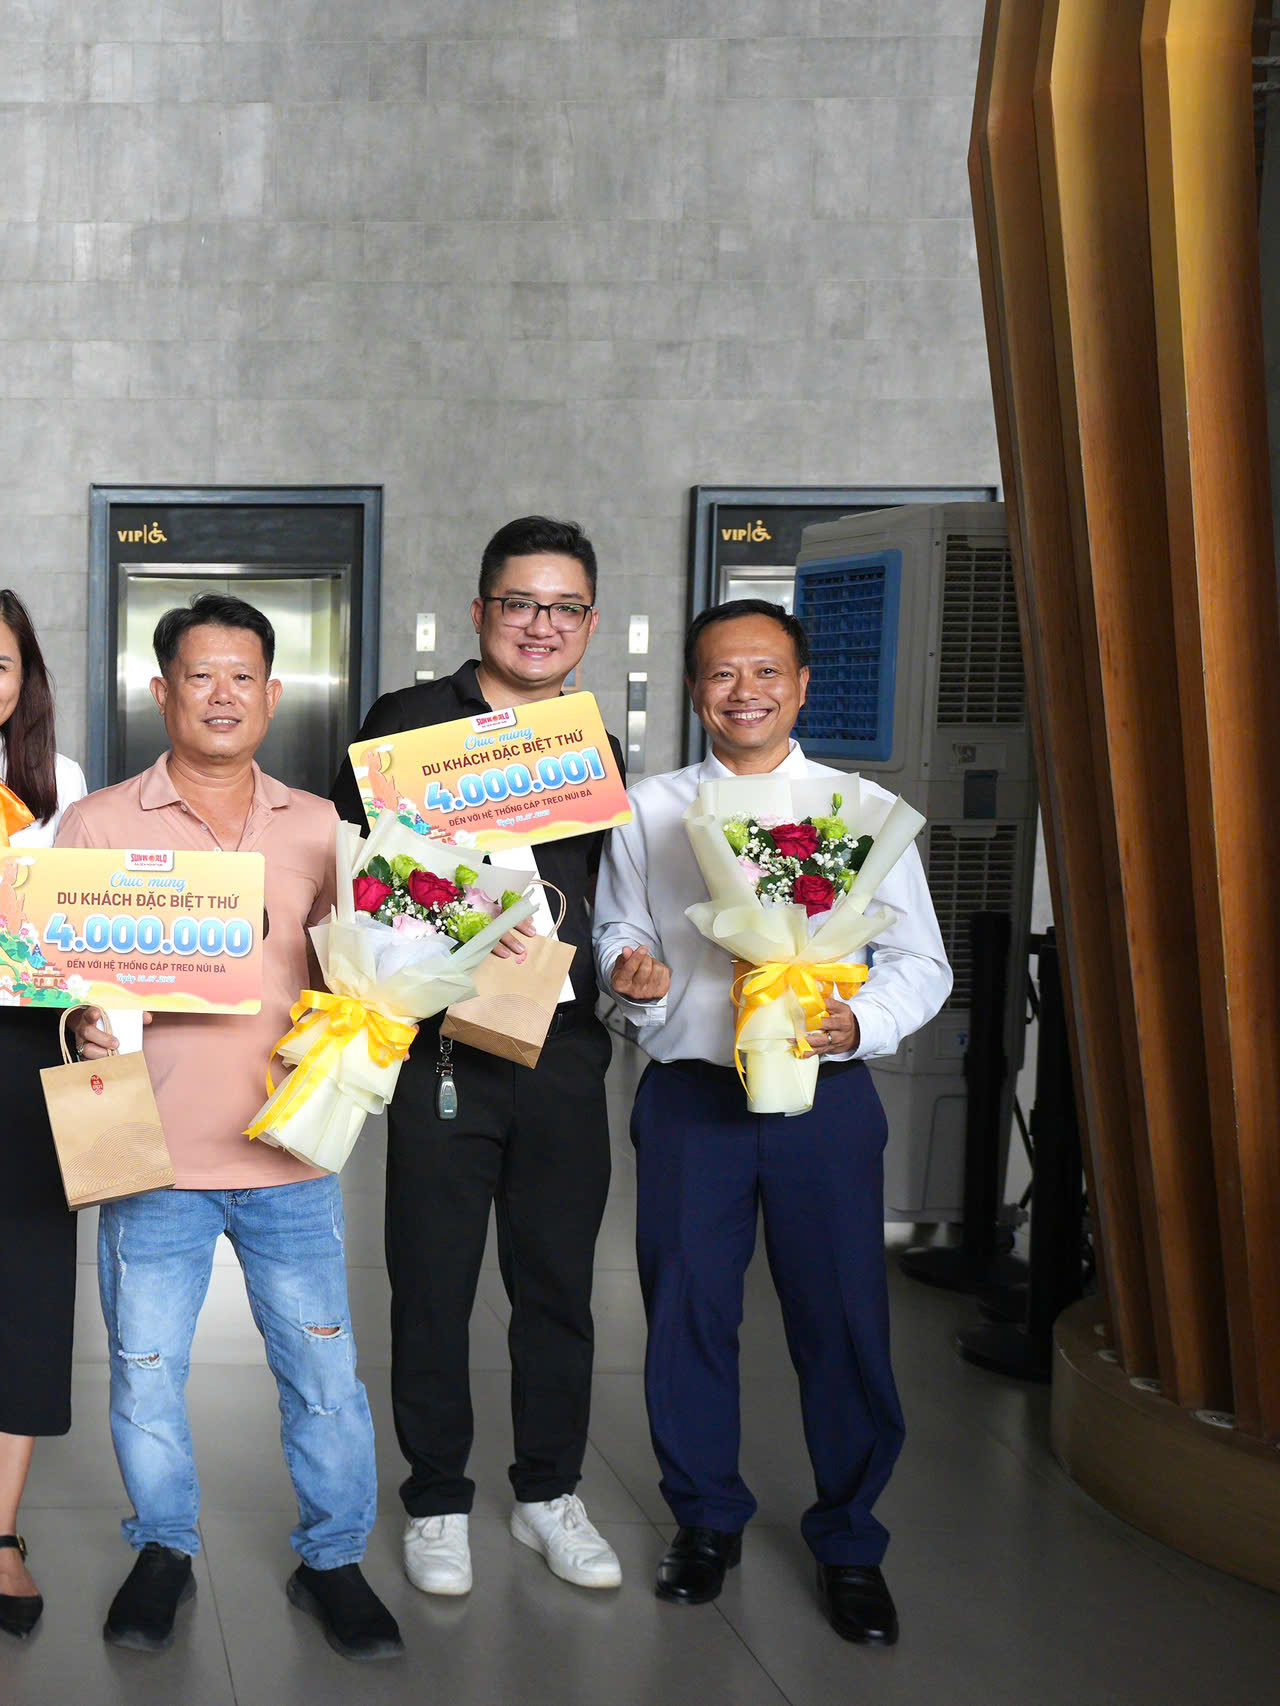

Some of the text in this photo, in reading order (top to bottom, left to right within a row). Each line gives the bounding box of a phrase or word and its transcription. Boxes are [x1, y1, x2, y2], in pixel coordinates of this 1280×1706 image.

[117, 530, 143, 543] VIP
[722, 528, 746, 542] VIP
[422, 728, 584, 777] DU KHÁCH ĐẶC BIỆT THỨ
[425, 748, 606, 814] 4.000.001
[542, 795, 564, 807] TREO
[110, 871, 144, 888] Chúc
[57, 890, 240, 911] DU KHÁCH ĐẶC BIỆT THỨ
[44, 913, 252, 957] 4.000.000
[67, 959, 87, 970] ĐẾN
[117, 959, 148, 971] THỐNG
[171, 963, 195, 972] TREO
[196, 963, 212, 973] NÚI
[214, 964, 226, 973] BÀ
